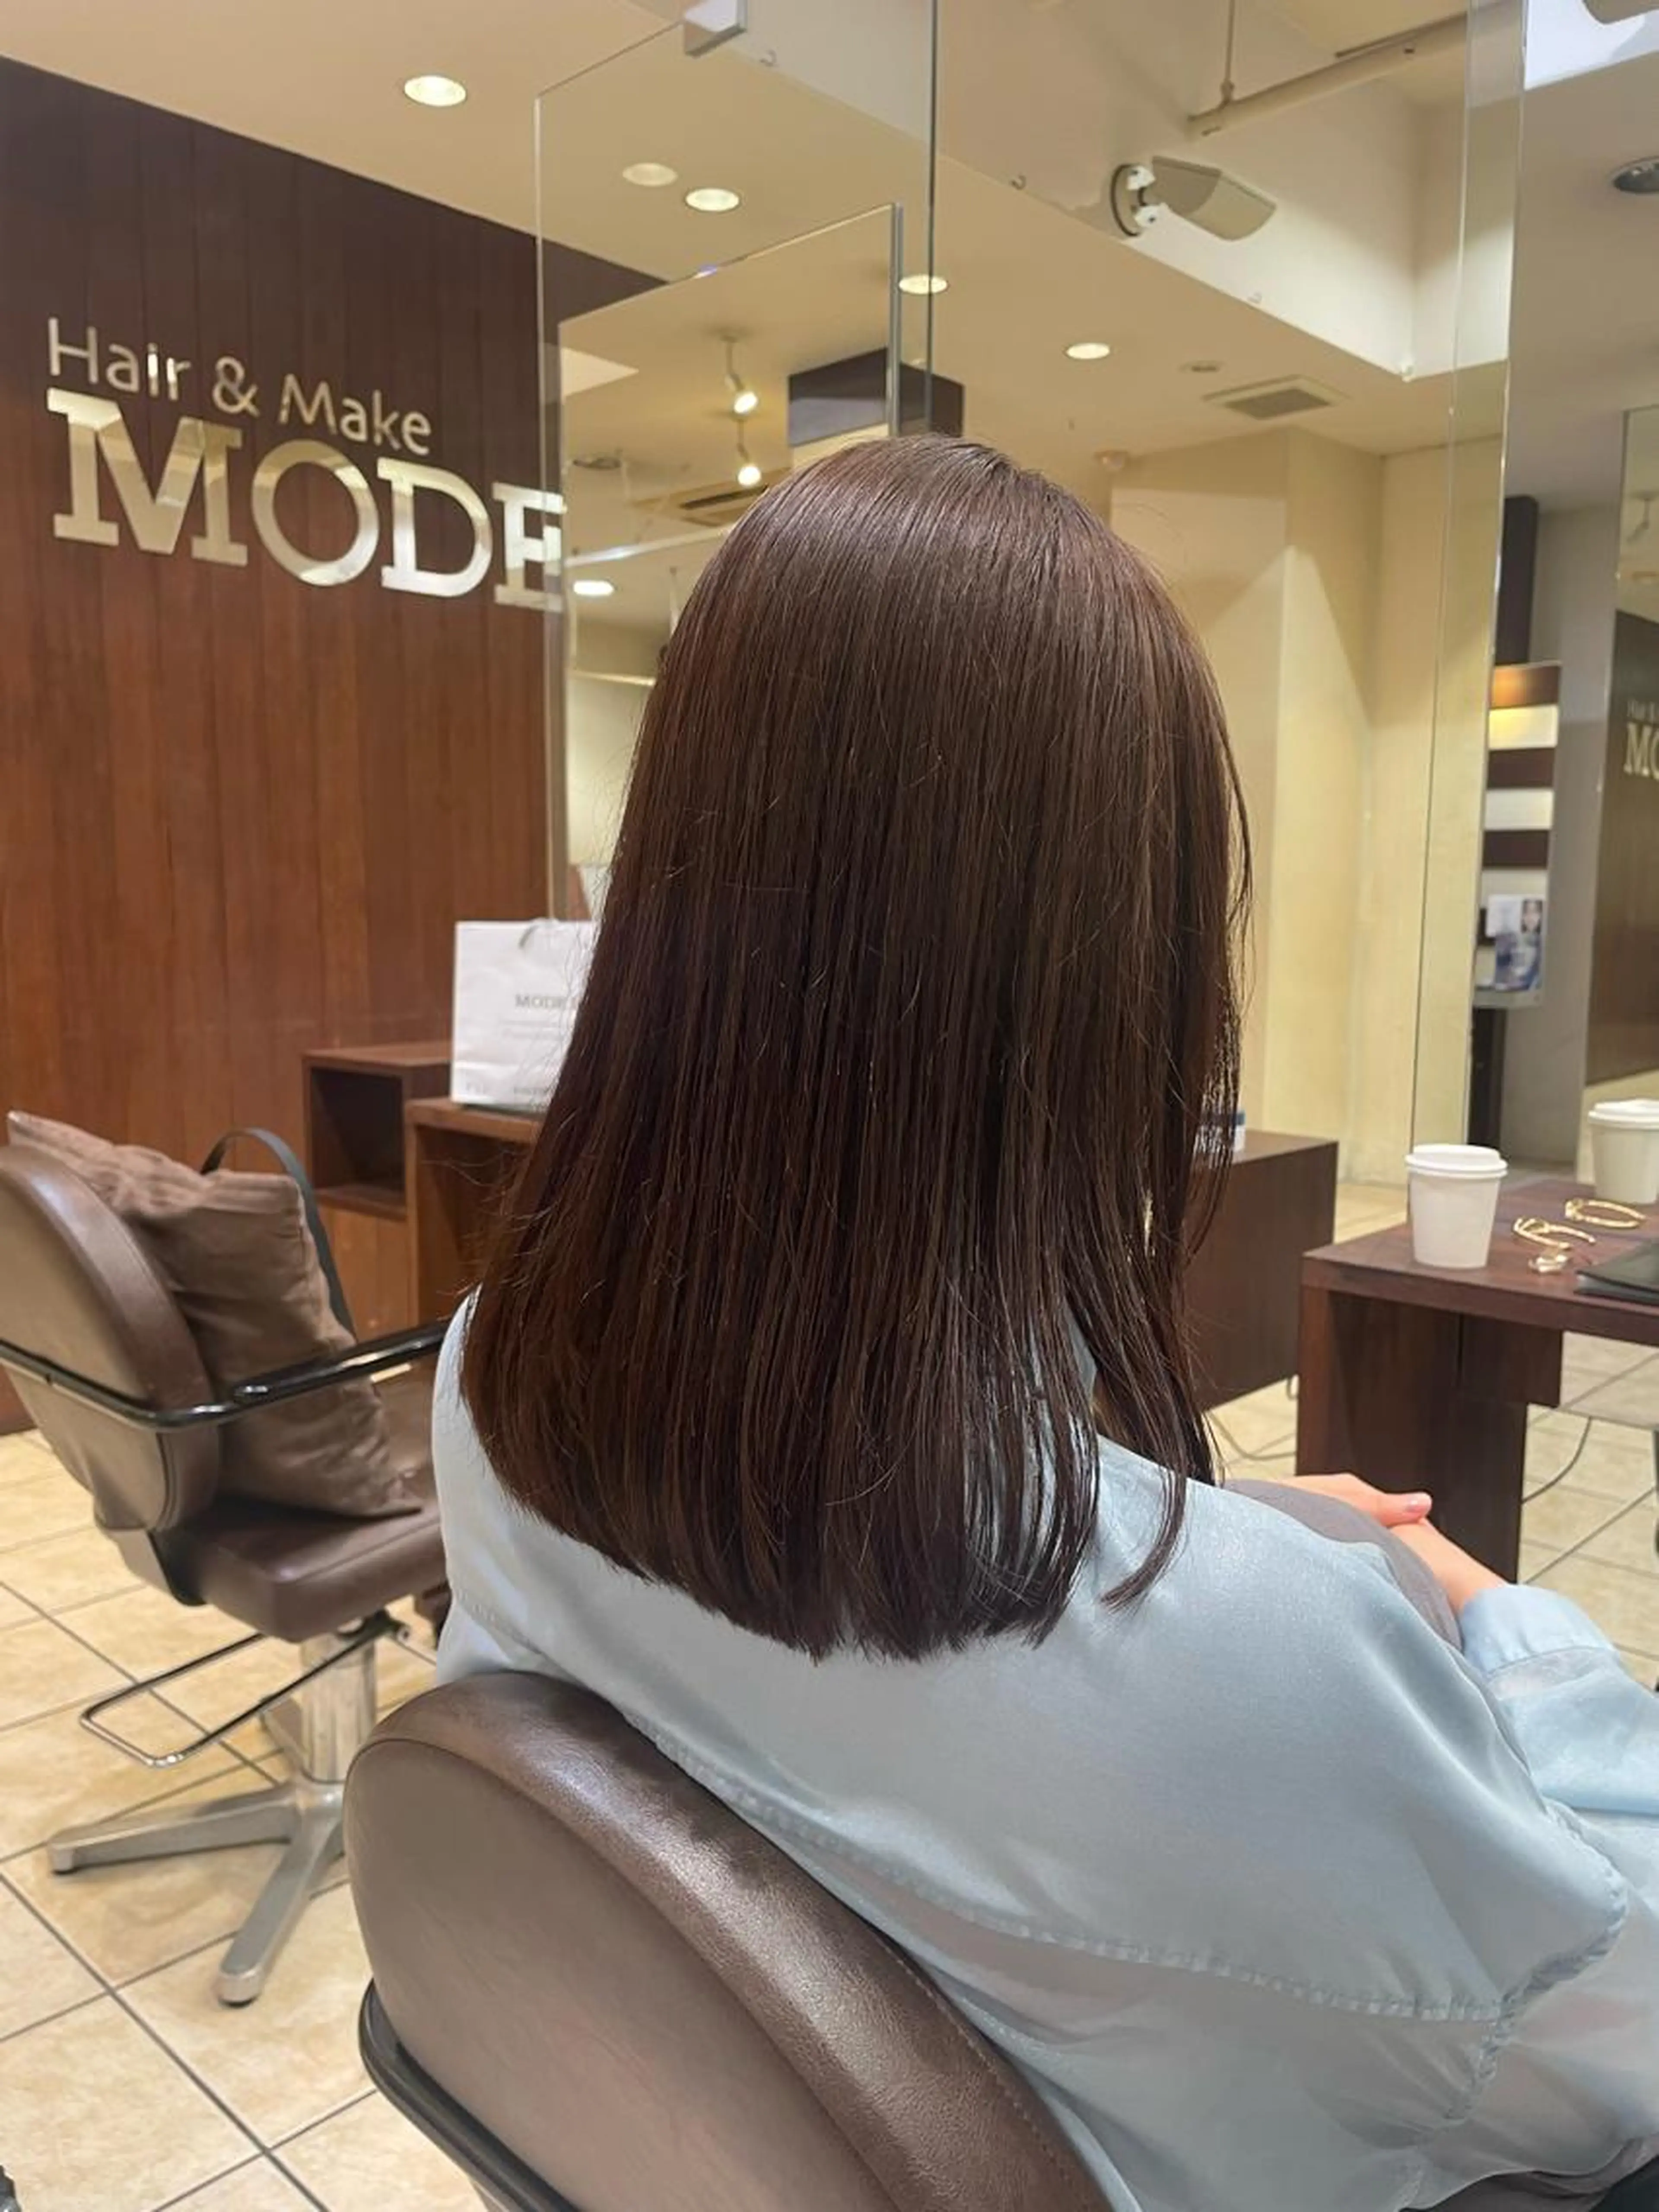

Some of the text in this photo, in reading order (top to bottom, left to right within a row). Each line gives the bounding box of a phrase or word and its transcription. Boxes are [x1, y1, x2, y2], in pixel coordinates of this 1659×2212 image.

[48, 318, 432, 455] Hair & Make
